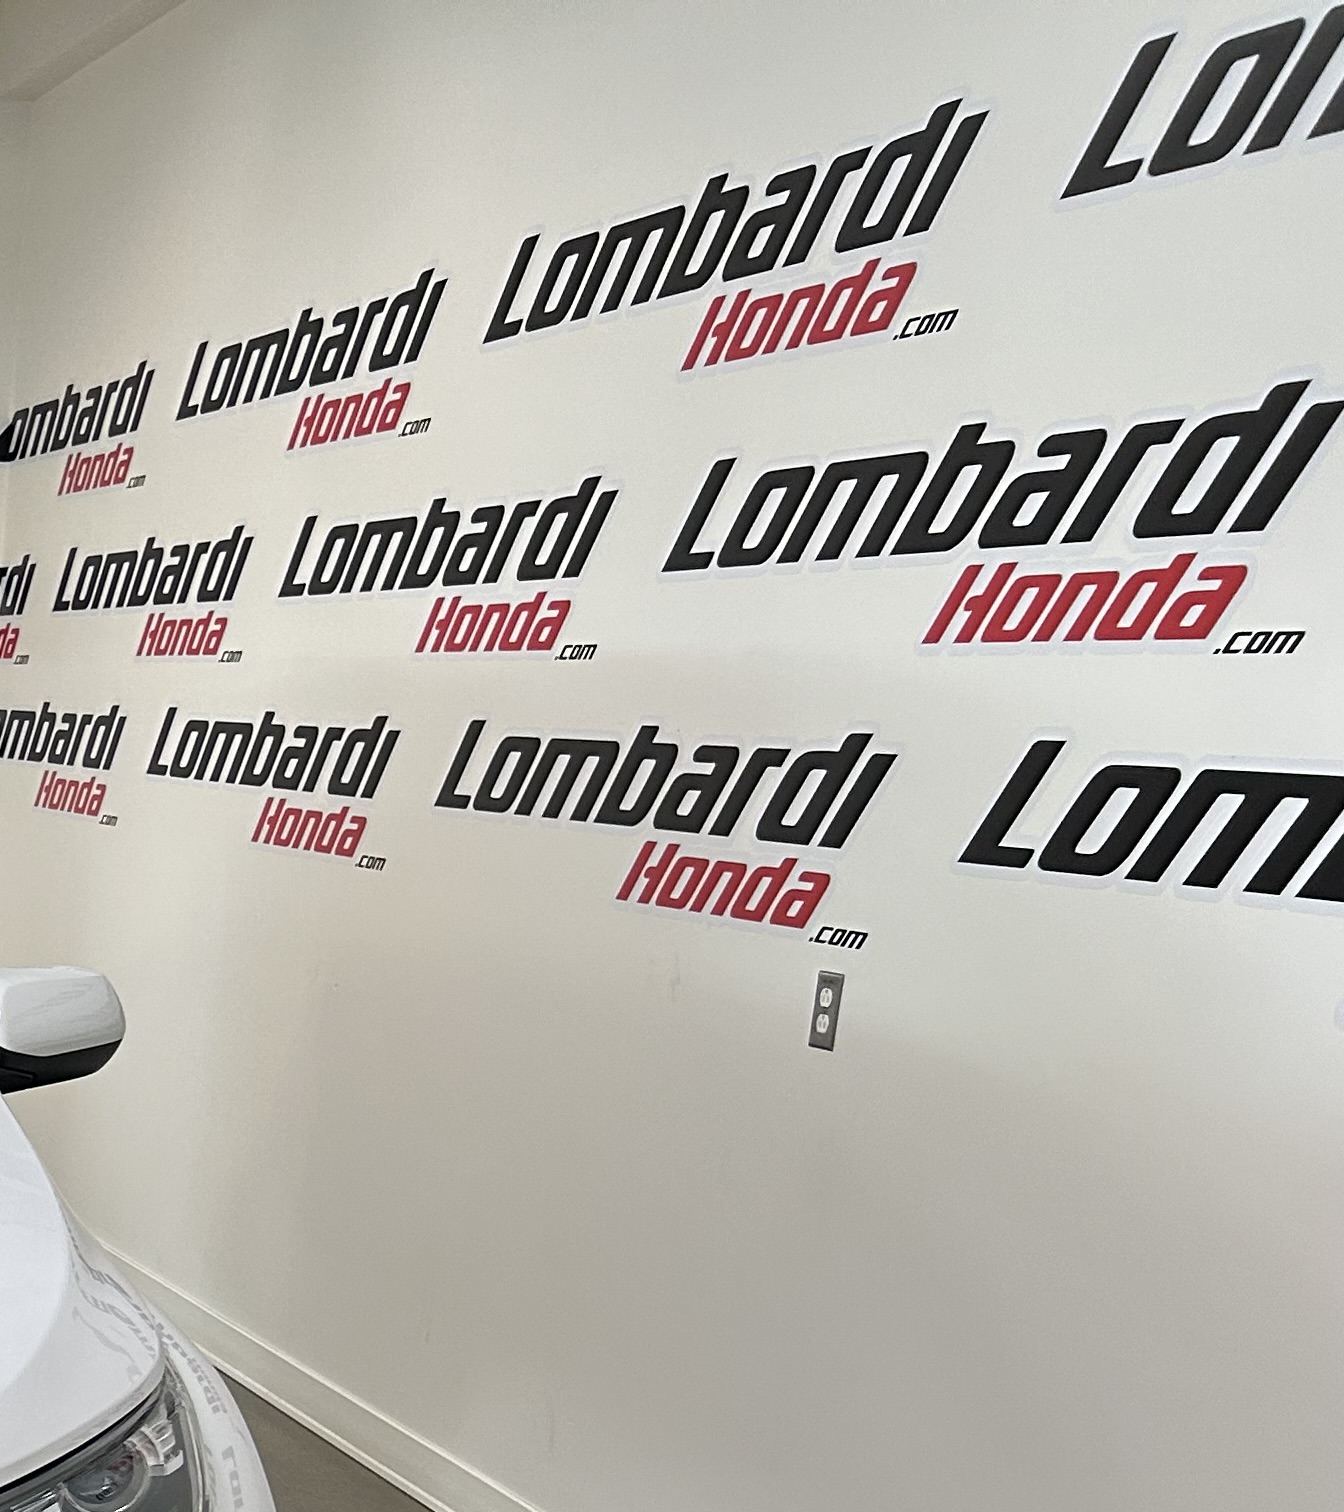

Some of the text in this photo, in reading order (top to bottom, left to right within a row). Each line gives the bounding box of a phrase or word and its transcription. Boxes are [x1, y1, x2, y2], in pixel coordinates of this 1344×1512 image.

[483, 98, 990, 344] Lombardi
[176, 268, 449, 420] Lombardi
[681, 258, 959, 371] Honda .com
[287, 379, 431, 451] Honda .com
[58, 444, 134, 496] Honda
[661, 379, 1344, 573] Lombardi
[53, 525, 254, 612] Lombardi
[278, 476, 619, 598] Lombardi
[137, 612, 227, 656] Honda
[415, 592, 598, 660] Honda .com
[922, 553, 1306, 654] Honda .com
[34, 770, 107, 816] Honda
[147, 707, 401, 799] Lombardi
[434, 720, 898, 849] Lombardi
[251, 797, 386, 871] Honda .com
[616, 841, 869, 950] Honda .com
